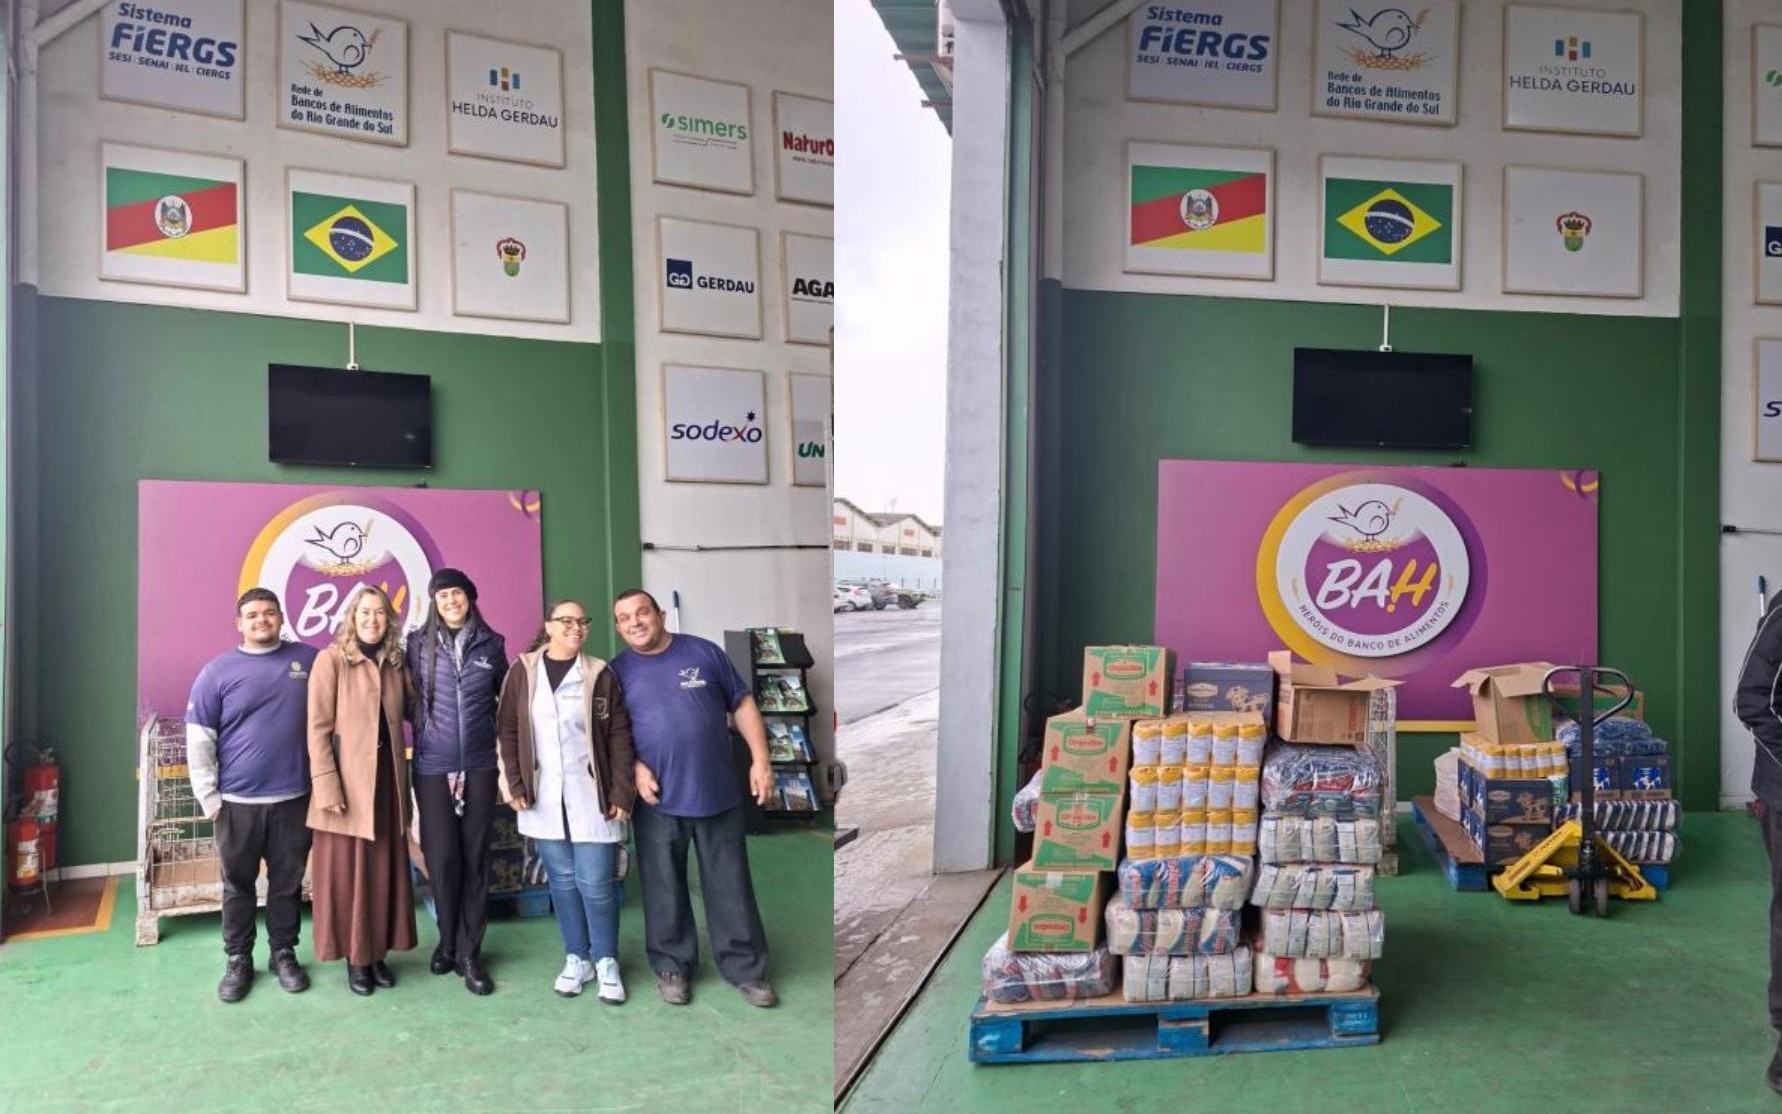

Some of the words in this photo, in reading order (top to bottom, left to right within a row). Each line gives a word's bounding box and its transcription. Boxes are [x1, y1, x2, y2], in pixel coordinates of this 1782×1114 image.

[118, 2, 192, 28] Sistema
[1147, 5, 1222, 26] Sistema
[109, 51, 132, 63] SESI
[138, 57, 169, 69] SENAI
[175, 62, 190, 74] IEL
[196, 67, 231, 80] CIERGS
[1136, 54, 1160, 64] SESI
[1166, 56, 1199, 67] SENAI
[1204, 59, 1219, 70] IEL
[1226, 61, 1263, 73] CIERGS
[1540, 66, 1606, 79] INSTITUTO
[1328, 71, 1350, 81] Rede
[1352, 72, 1362, 82] de
[1509, 75, 1562, 91] HELDA
[1567, 79, 1635, 96] GERDAU
[291, 83, 312, 96] Rede
[313, 87, 323, 97] de
[477, 92, 534, 109] INSTITUTO
[1328, 82, 1367, 95] Bancos
[1370, 85, 1382, 97] de
[1385, 86, 1440, 102] Alimentos
[291, 94, 327, 111] Bancos
[329, 101, 341, 113] de
[344, 103, 393, 122] Alimentos
[452, 101, 498, 120] HELDA
[500, 109, 558, 128] GERDAU
[1327, 96, 1340, 107] do
[1343, 97, 1361, 109] Rio
[1364, 98, 1403, 113] Grande
[1406, 102, 1420, 113] do
[1422, 103, 1440, 115] Sul
[291, 108, 304, 120] do
[306, 110, 323, 124] Rio
[325, 113, 360, 130] Grande
[363, 120, 375, 132] do
[377, 121, 393, 135] Sul
[678, 115, 747, 140] simers
[697, 275, 755, 294] GERDAU
[671, 419, 763, 443] sodexo
[1299, 604, 1328, 635] HERÓIS
[1329, 632, 1345, 643] DO
[1347, 638, 1384, 650] BANCO
[1387, 639, 1401, 647] DE
[1404, 600, 1449, 643] ALIMENTOS
